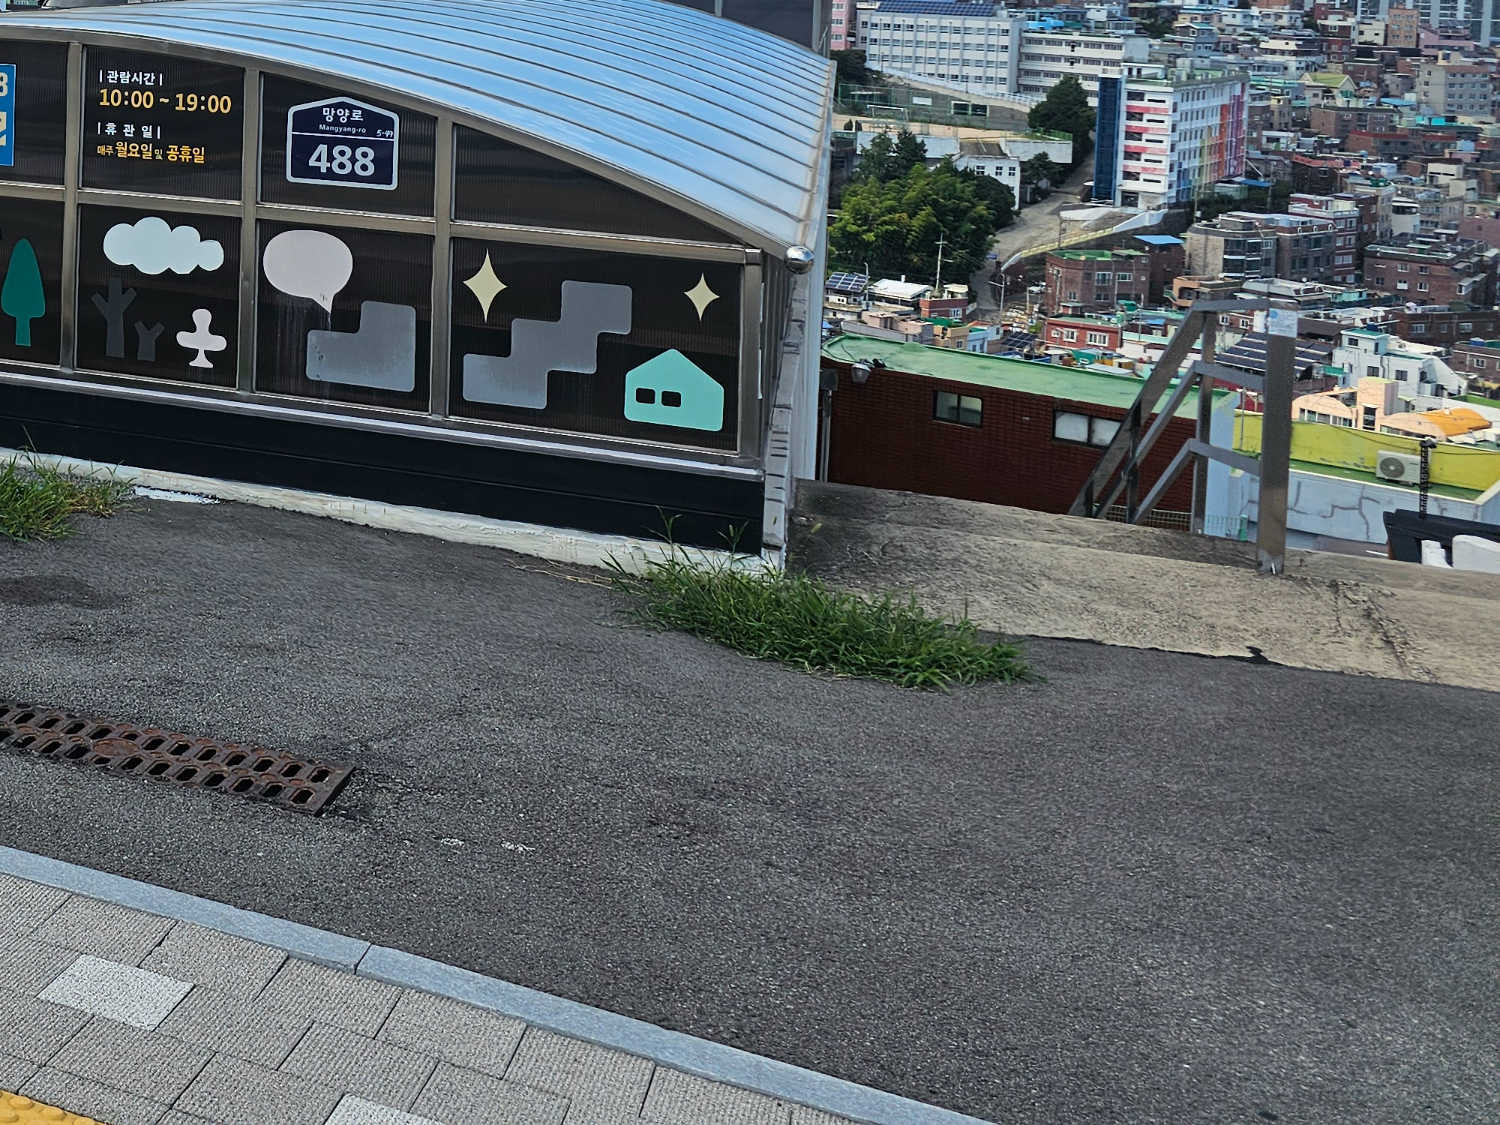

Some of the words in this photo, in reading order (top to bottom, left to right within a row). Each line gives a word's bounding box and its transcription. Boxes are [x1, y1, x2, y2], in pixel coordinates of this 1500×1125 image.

[107, 70, 155, 86] 관람시간
[99, 88, 154, 109] 10:00
[175, 93, 232, 114] 19:00
[322, 107, 364, 123] 망양로
[319, 124, 366, 134] Mangyang-ro
[97, 145, 114, 156] 매주
[115, 141, 153, 160] 월요일
[154, 148, 163, 160] 및
[166, 145, 205, 164] 공휴일
[308, 143, 375, 177] 488
